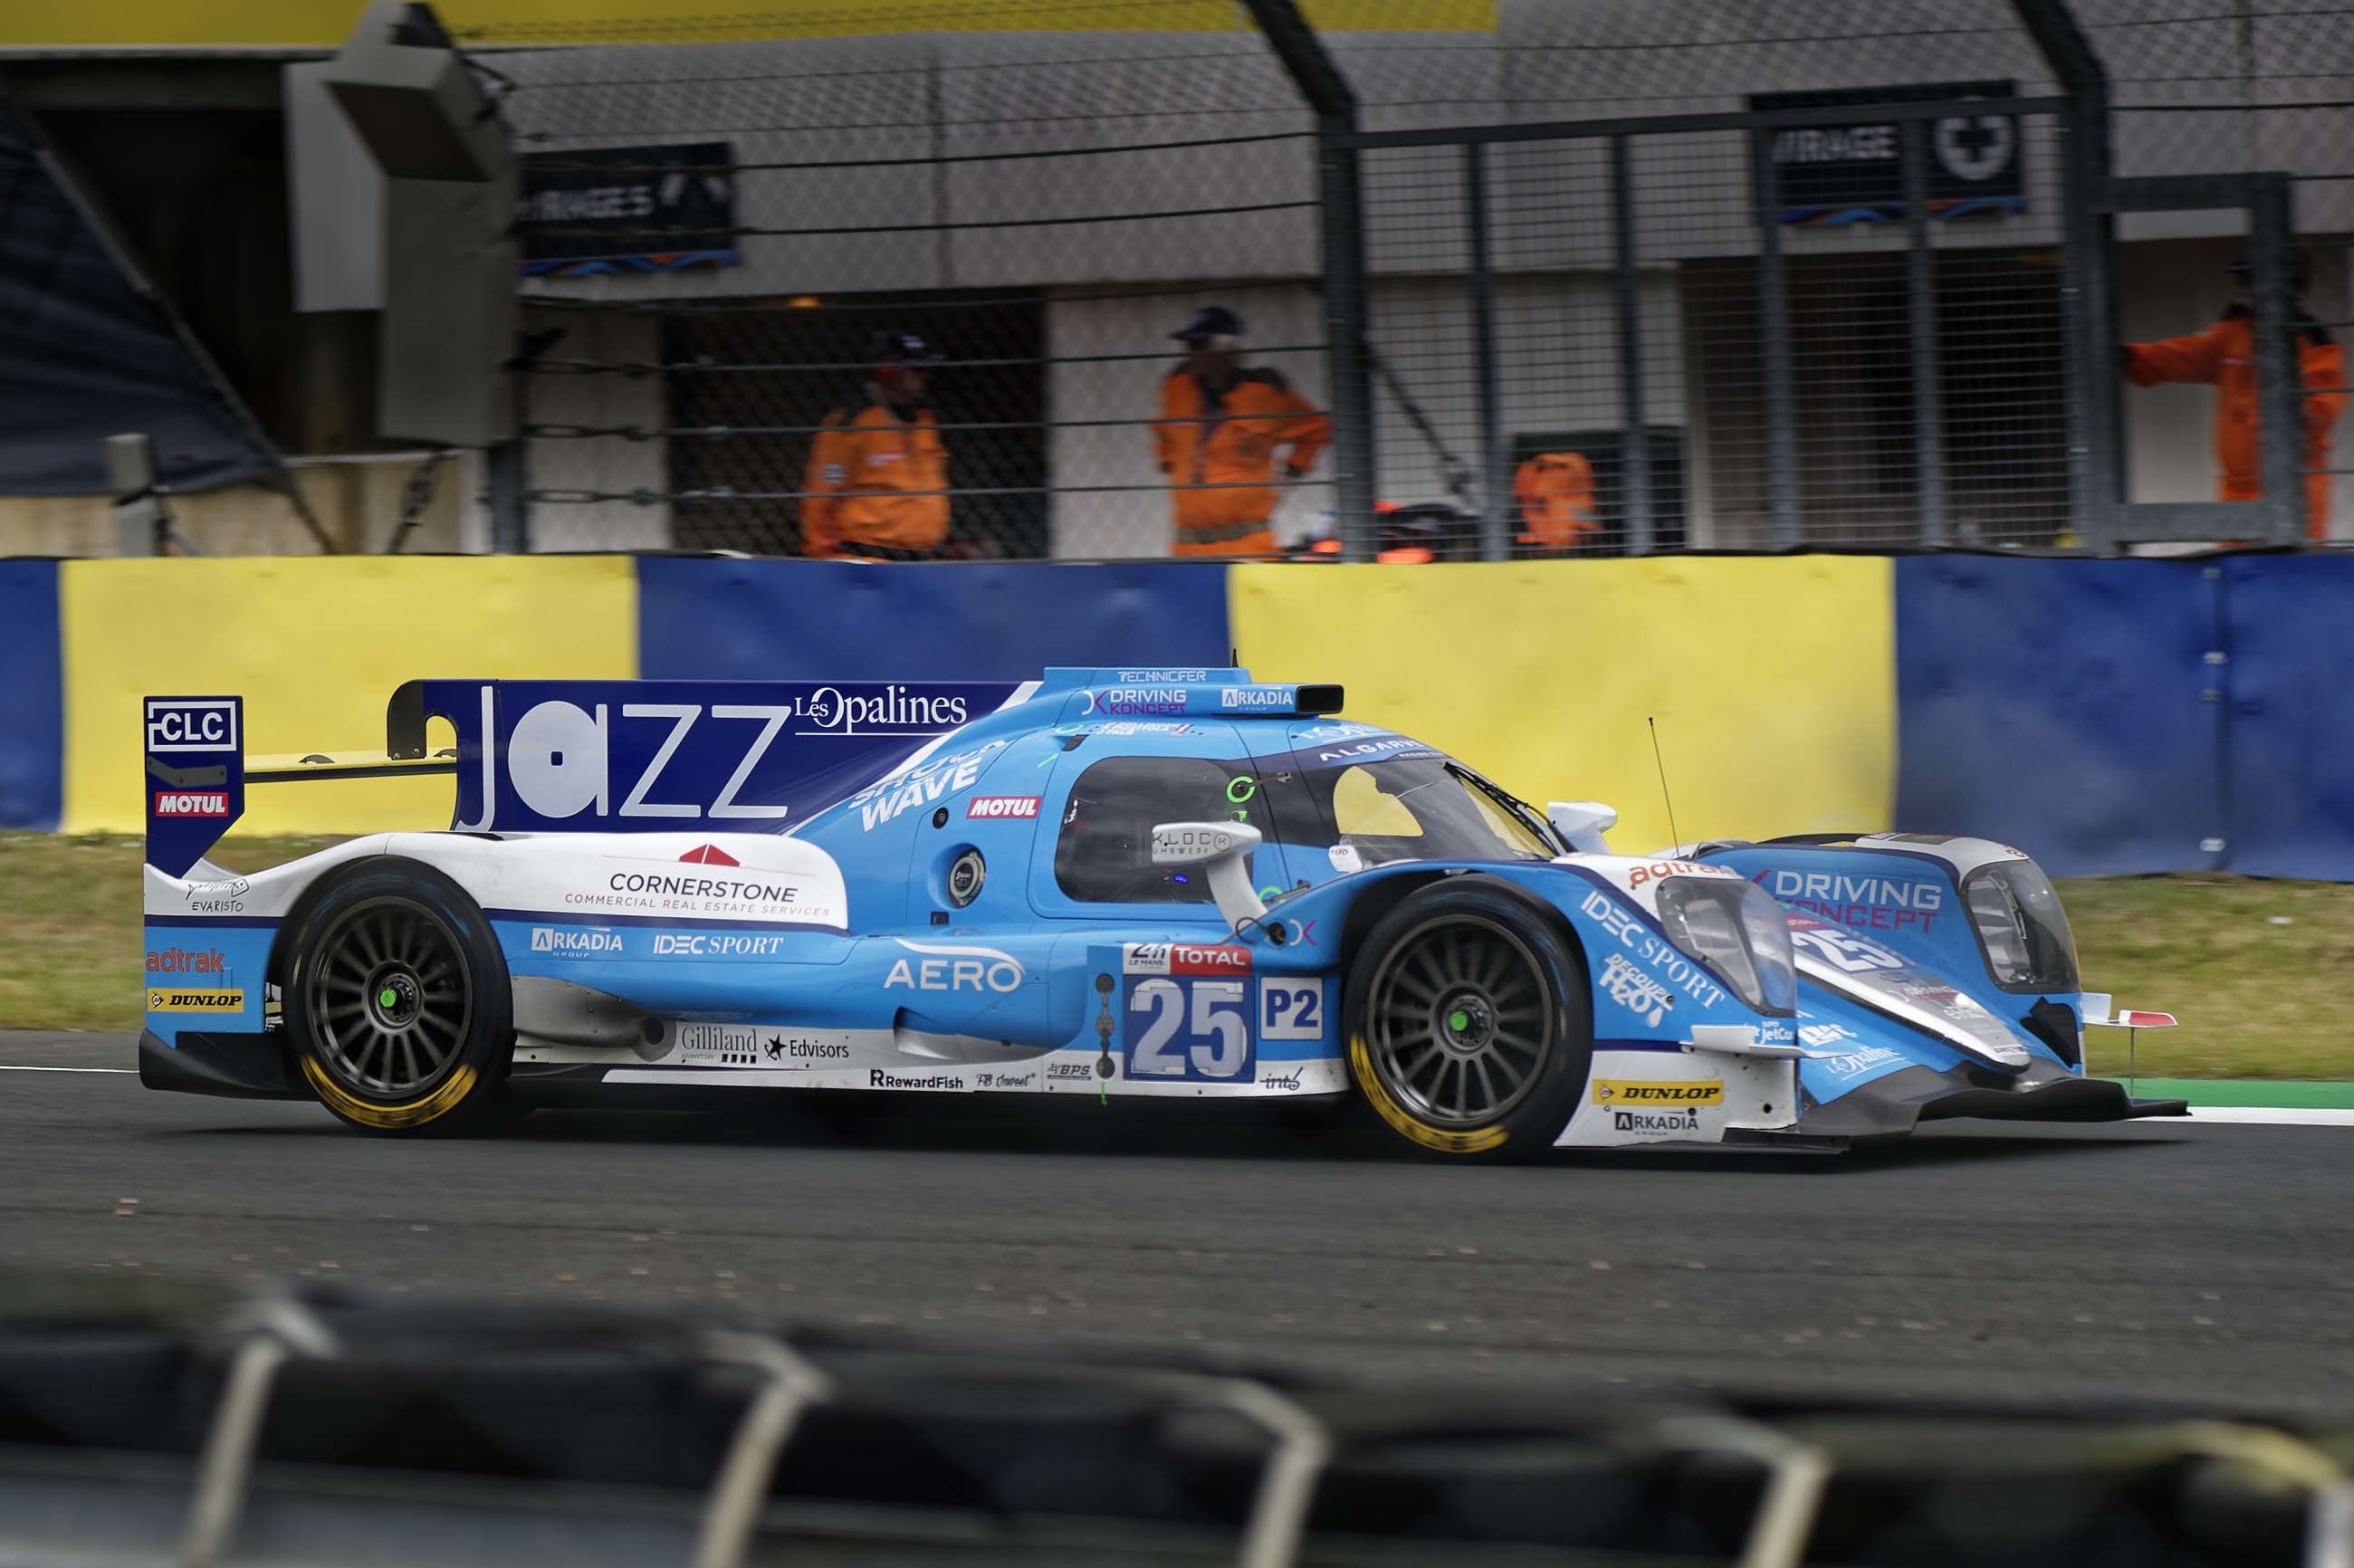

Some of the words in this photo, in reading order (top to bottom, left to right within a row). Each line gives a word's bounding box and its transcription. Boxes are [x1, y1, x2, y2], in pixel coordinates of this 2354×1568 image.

[1117, 671, 1206, 683] TECHNICFER
[795, 697, 828, 717] Les
[1110, 689, 1187, 703] DRIVING
[1222, 687, 1293, 707] ARKADIA
[811, 685, 967, 734] Opalines
[1109, 703, 1186, 715] KONCEPT
[161, 712, 224, 741] CLC
[455, 685, 791, 831] jazz
[158, 794, 225, 814] MOTUL
[862, 757, 981, 832] WAVE
[970, 799, 1037, 816] MOTUL
[610, 873, 799, 903] CORNERSTONE
[1775, 870, 1942, 910] DRIVING
[192, 900, 244, 913] EVARISTO
[565, 894, 655, 908] COMMERCIAL
[663, 899, 697, 910] REAL
[704, 902, 755, 913] ESTATE
[761, 905, 829, 916] SERVICES
[532, 927, 623, 951] ARKADIA
[653, 935, 706, 955] IDEC
[708, 936, 784, 955] SPORT
[1580, 891, 1644, 948] IDEC
[1637, 935, 1727, 1009] SPORT
[146, 948, 225, 972] adtrak
[1175, 947, 1246, 966] TOTAL
[1790, 929, 1904, 972] 25
[884, 959, 1021, 992] AERO
[169, 994, 242, 1007] DUNLOP
[1266, 989, 1318, 1028] P2
[1131, 978, 1248, 1077] 25
[682, 1027, 758, 1052] Gilliland
[789, 1039, 849, 1057] Edvisors
[885, 1076, 963, 1089] RewardFish
[1622, 1088, 1719, 1099] DUNLOP
